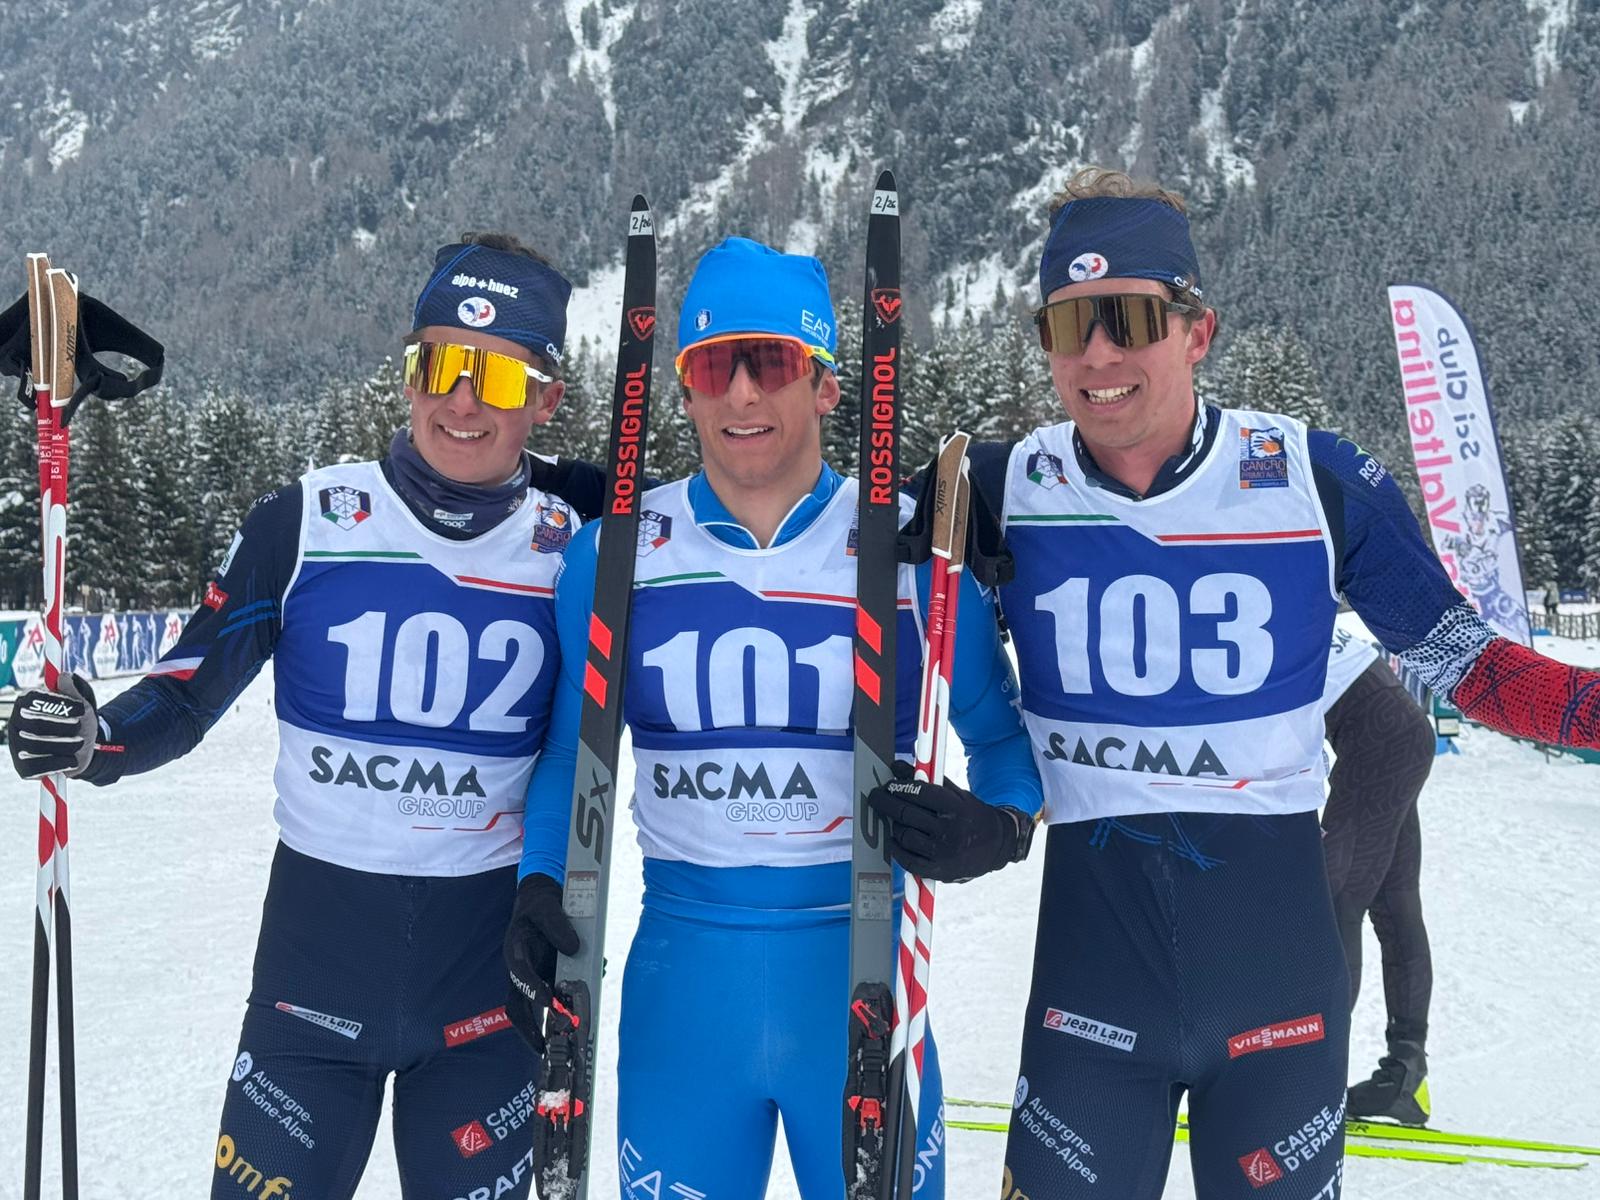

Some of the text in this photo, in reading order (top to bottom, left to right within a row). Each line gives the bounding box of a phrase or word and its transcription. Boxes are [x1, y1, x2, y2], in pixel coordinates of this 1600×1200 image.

[451, 272, 519, 299] alpe huez
[801, 309, 831, 341] EA7
[612, 363, 646, 515] ROSSIGNOL
[870, 347, 896, 505] ROSSIGNOL
[1241, 459, 1286, 471] CANCRO
[1034, 572, 1274, 696] 103
[327, 610, 545, 732] 102
[642, 627, 855, 737] 101
[309, 746, 487, 797] SACMA
[1043, 732, 1229, 777] SACMA
[653, 762, 818, 800] SACMA
[887, 782, 922, 795] sportful
[398, 796, 487, 818] GROUP
[726, 802, 819, 822] GROUP
[449, 1012, 508, 1038] VIESSMA
[1062, 1017, 1099, 1035] Jean
[1100, 1027, 1134, 1045] Lain
[1234, 1022, 1320, 1050] VIESSMANN
[242, 1080, 316, 1149] Rhône-Alpes
[251, 1070, 313, 1124] Auvergne-
[486, 1080, 536, 1127] CAISSE
[1028, 1097, 1095, 1157] Auvergne-
[1274, 1105, 1333, 1157] CAISSE
[1283, 1087, 1348, 1172] D'EPARGN
